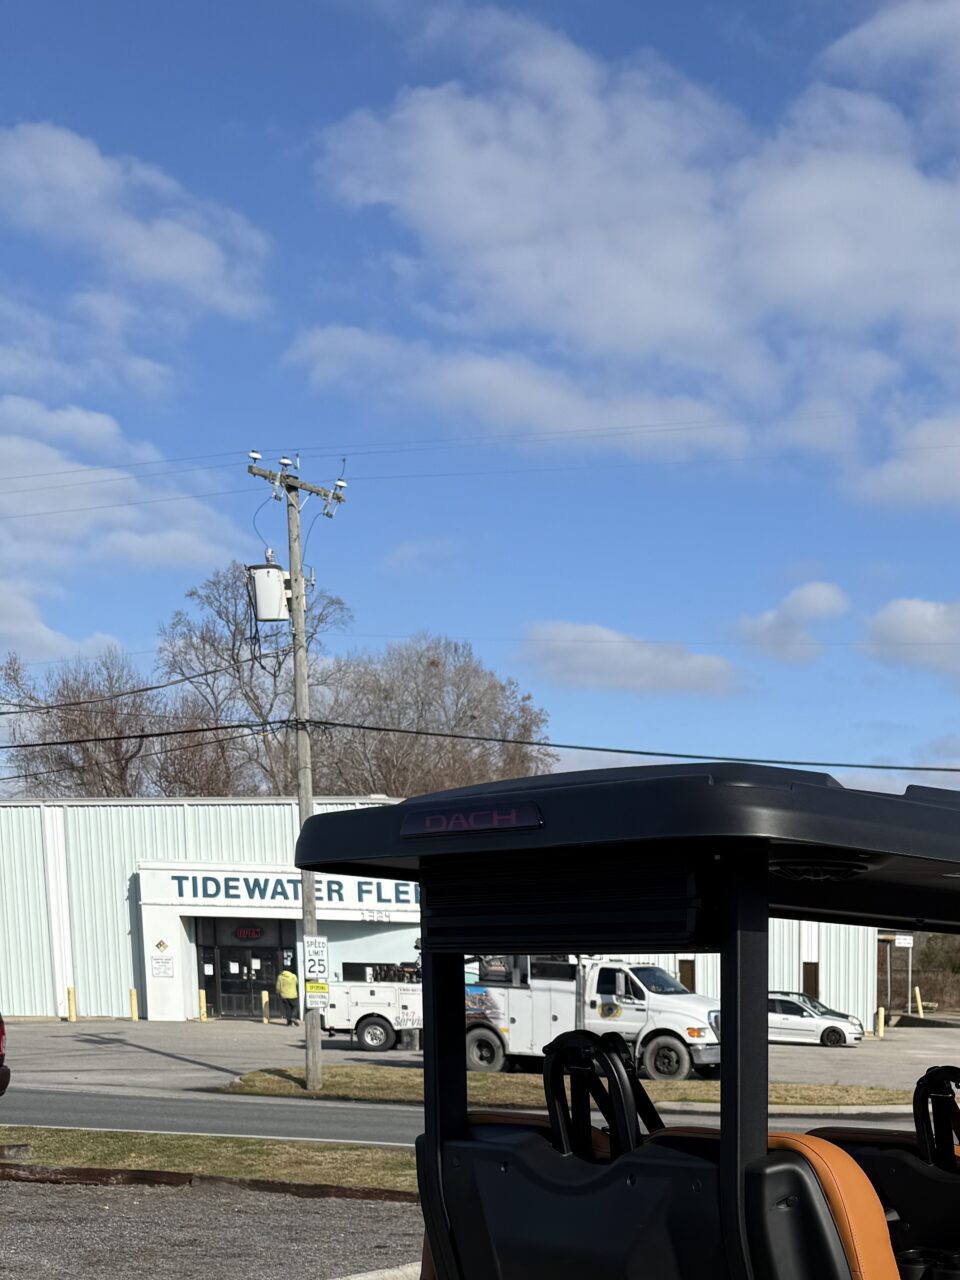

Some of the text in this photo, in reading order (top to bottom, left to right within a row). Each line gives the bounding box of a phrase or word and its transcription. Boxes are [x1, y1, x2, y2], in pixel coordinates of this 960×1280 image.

[424, 808, 517, 832] DACH
[306, 939, 326, 949] SPEED
[308, 958, 326, 974] 25
